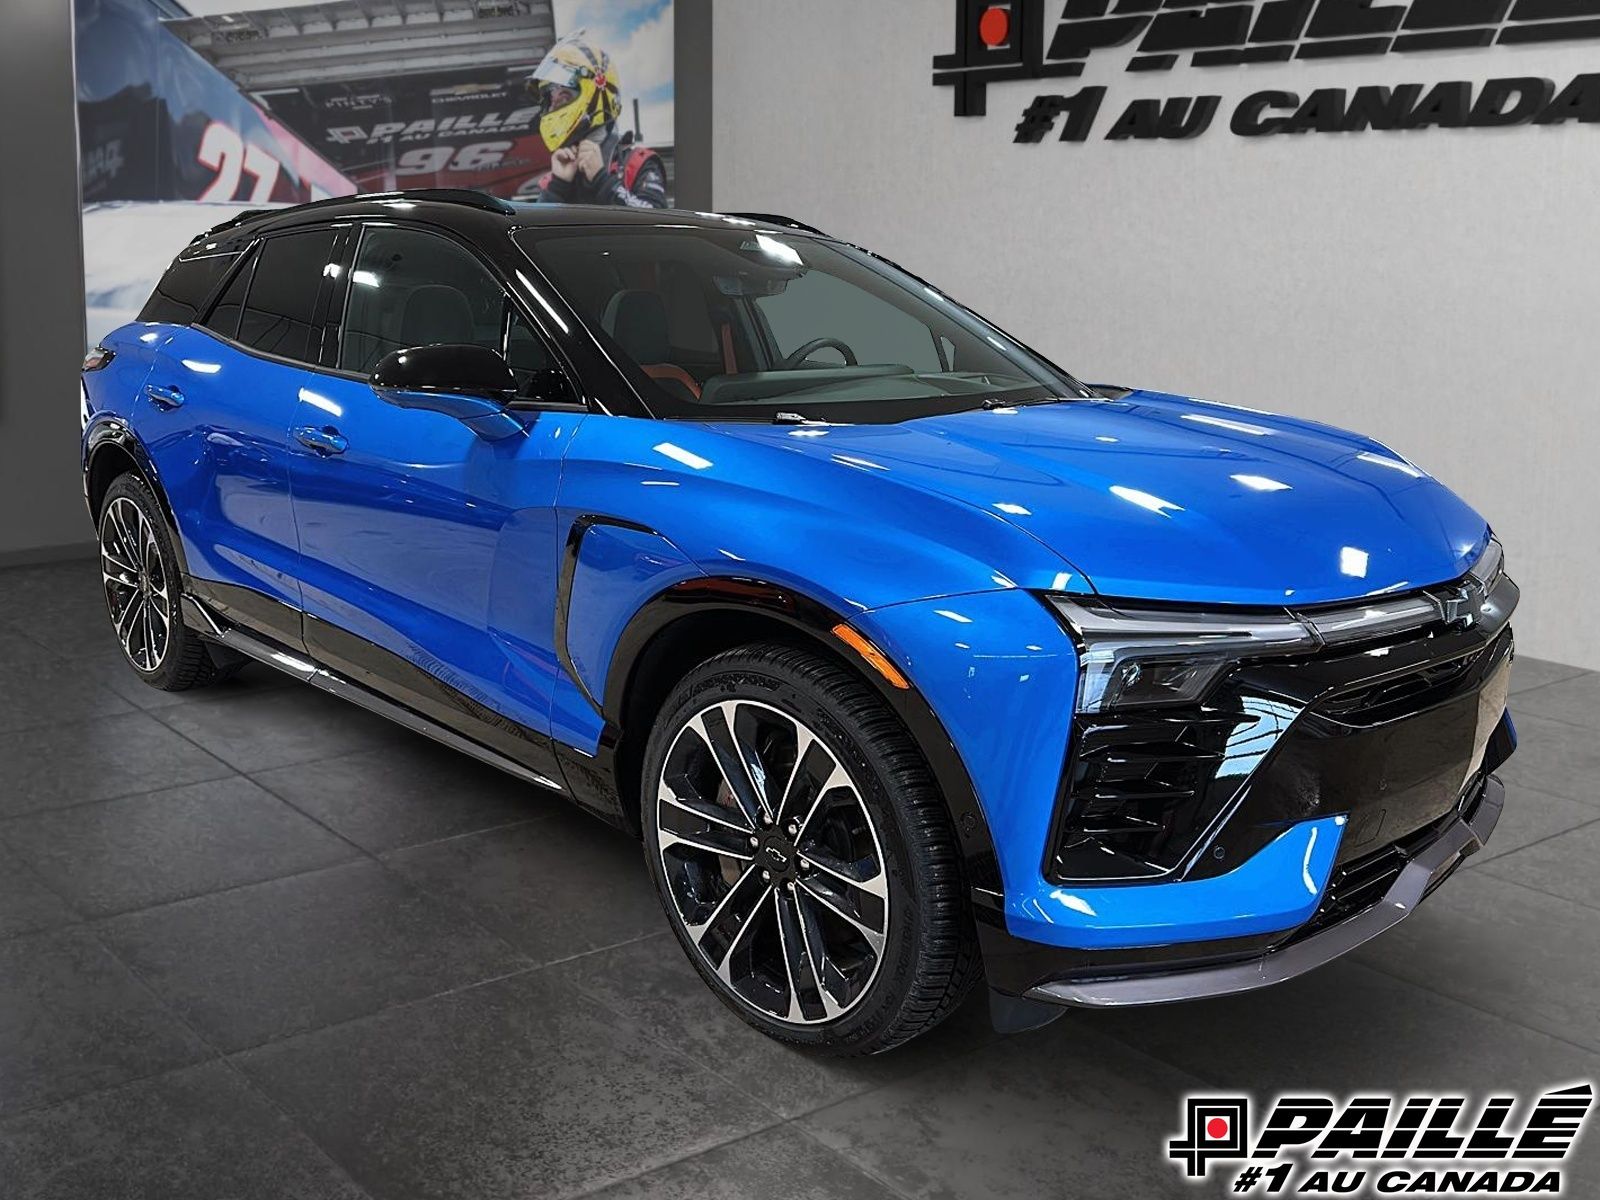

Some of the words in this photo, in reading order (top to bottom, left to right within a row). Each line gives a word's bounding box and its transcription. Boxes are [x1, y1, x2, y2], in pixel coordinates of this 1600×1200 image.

[437, 123, 530, 139] CANADA
[1013, 85, 1108, 144] #1
[1104, 95, 1222, 141] AU
[1229, 73, 1600, 137] CANADA
[197, 120, 280, 205] 27
[395, 140, 513, 177] 96
